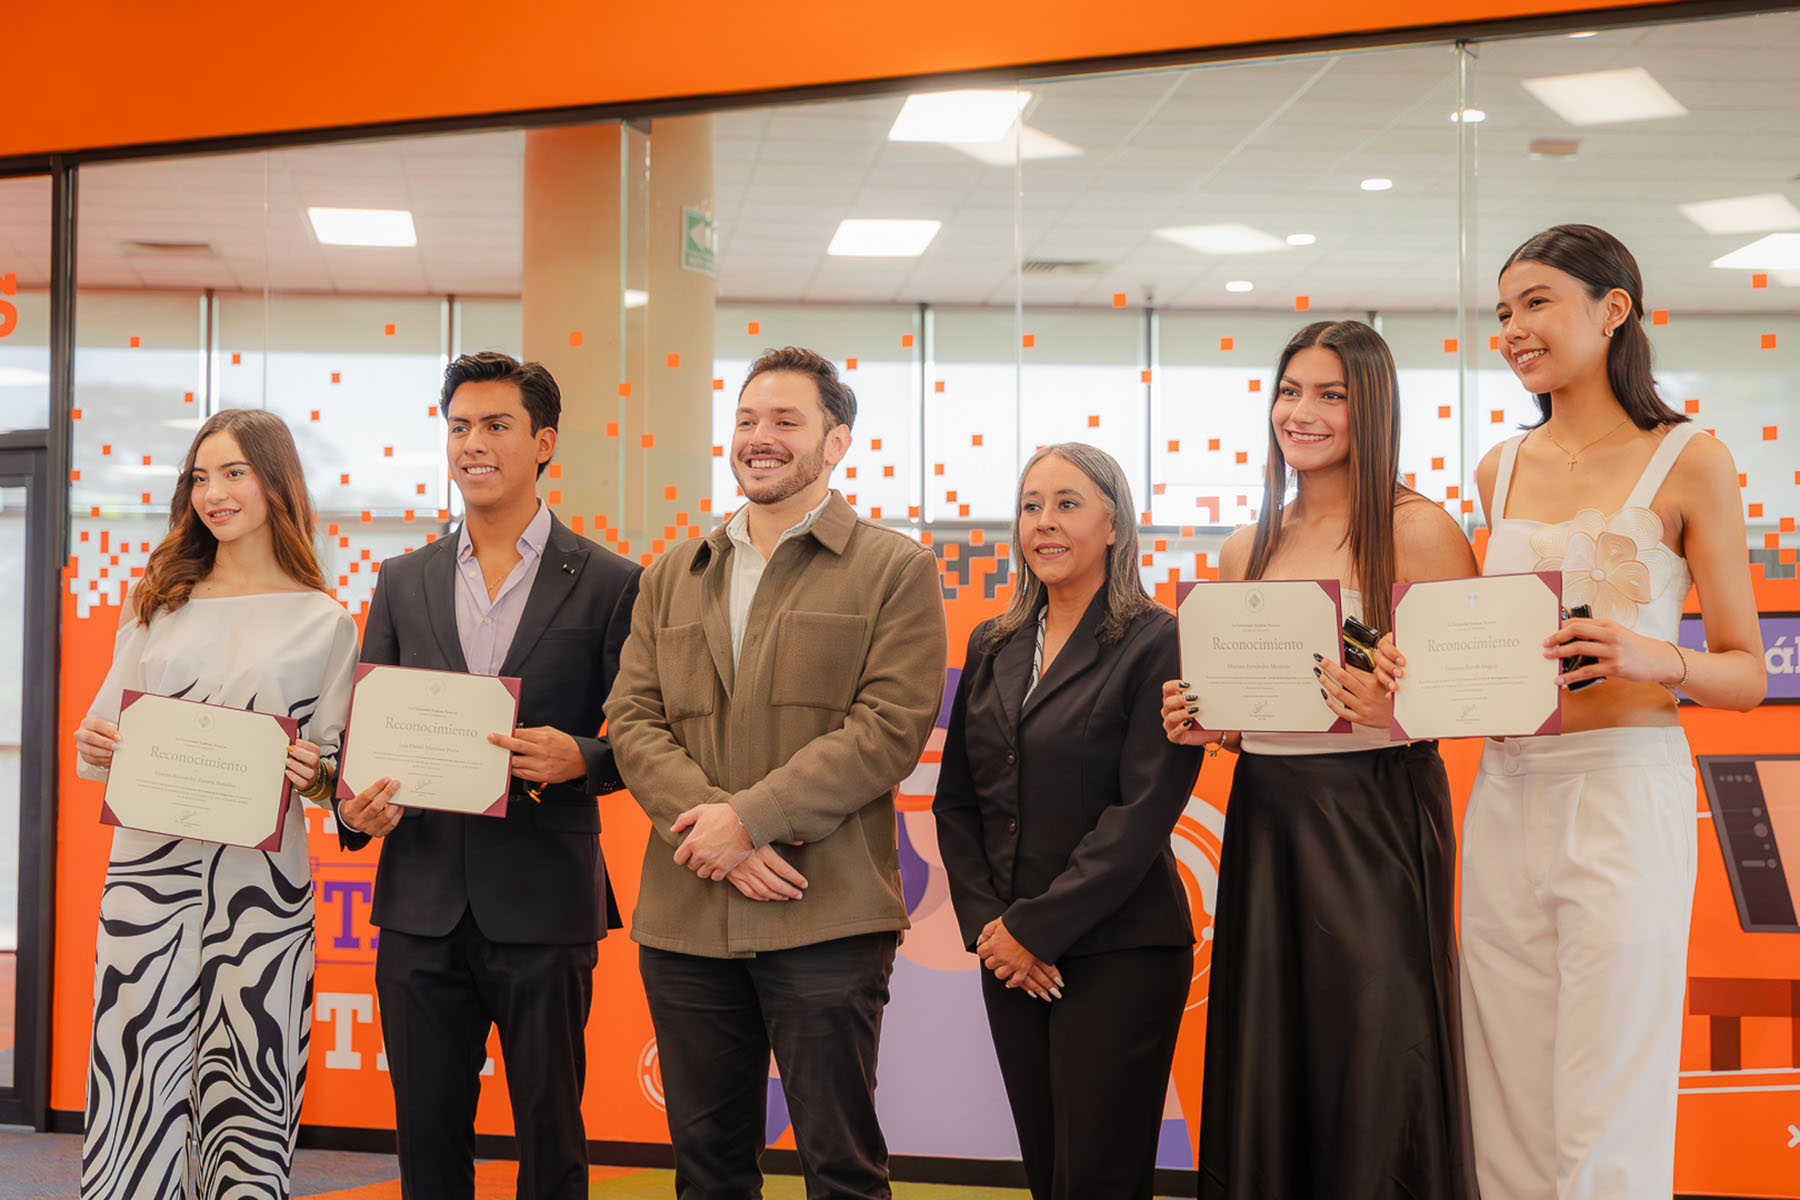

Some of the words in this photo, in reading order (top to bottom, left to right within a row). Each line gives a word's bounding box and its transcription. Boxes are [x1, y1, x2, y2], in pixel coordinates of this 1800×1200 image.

[1212, 636, 1304, 650] Reconocimiento
[1427, 635, 1520, 653] Reconocimiento
[385, 716, 478, 737] Reconocimiento
[150, 745, 248, 773] Reconocimiento
